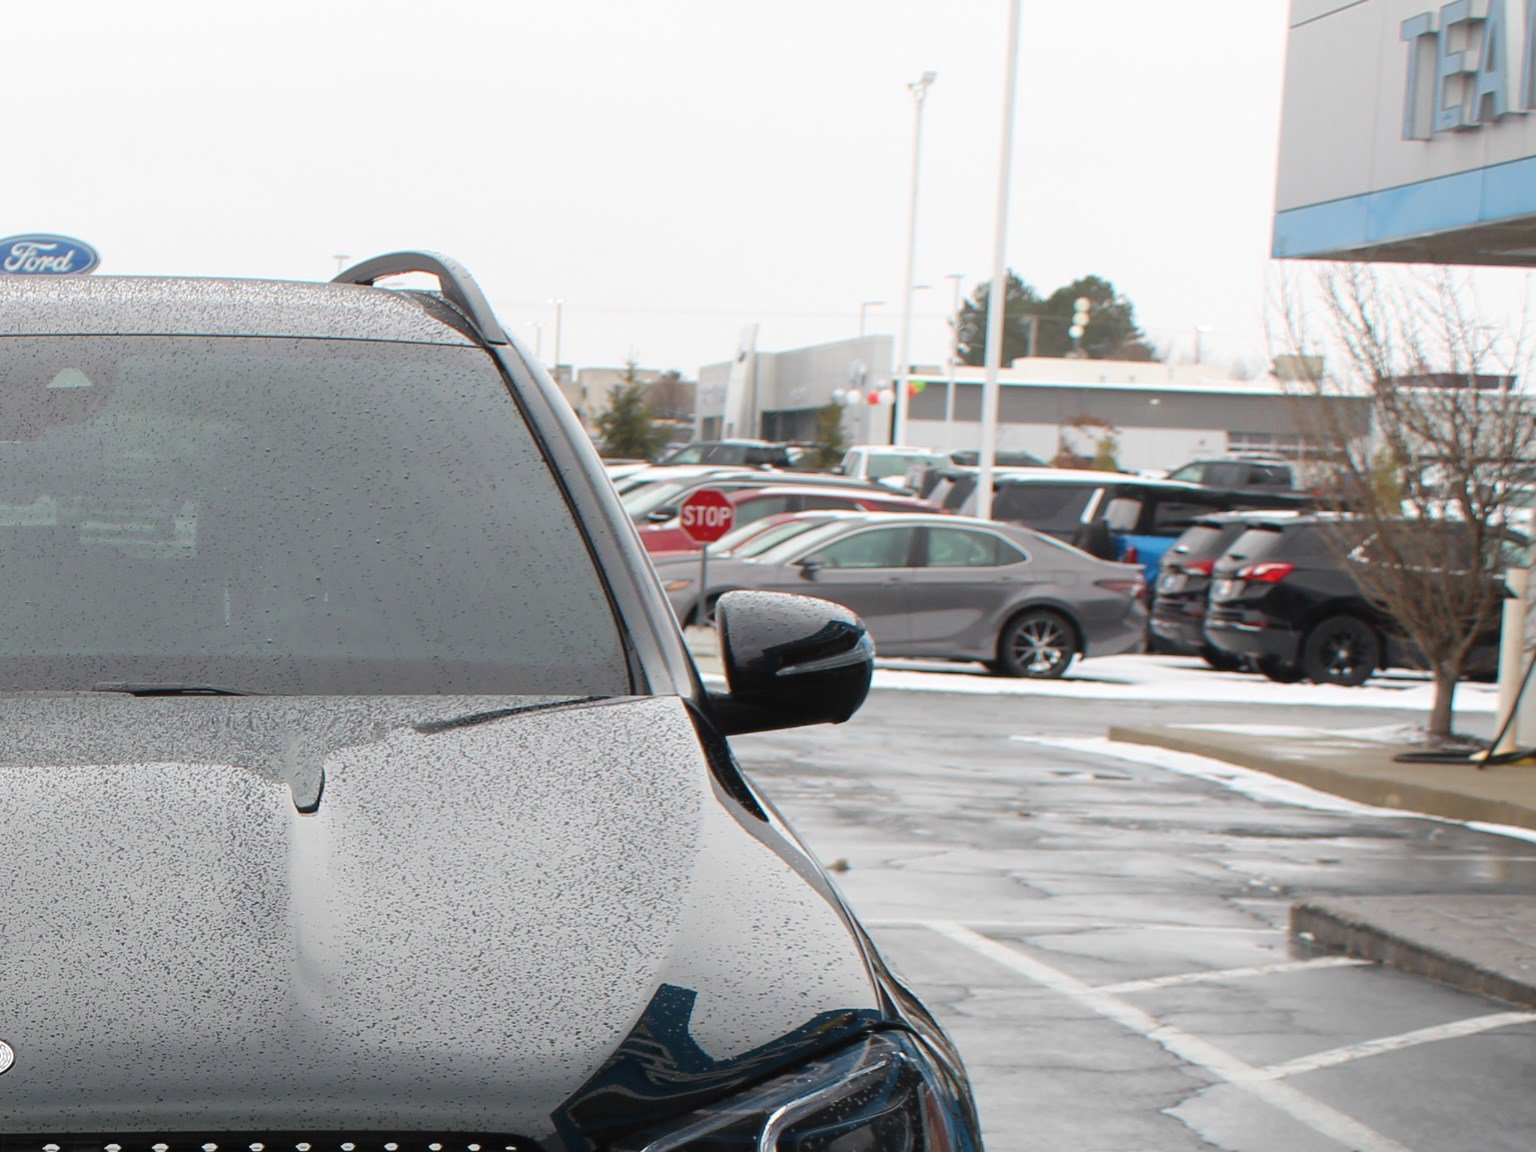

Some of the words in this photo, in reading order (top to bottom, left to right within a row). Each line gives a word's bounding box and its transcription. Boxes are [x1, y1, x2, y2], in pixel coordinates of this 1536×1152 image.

[1400, 0, 1536, 141] TEA
[3, 241, 76, 273] Ford
[682, 504, 733, 528] STOP
